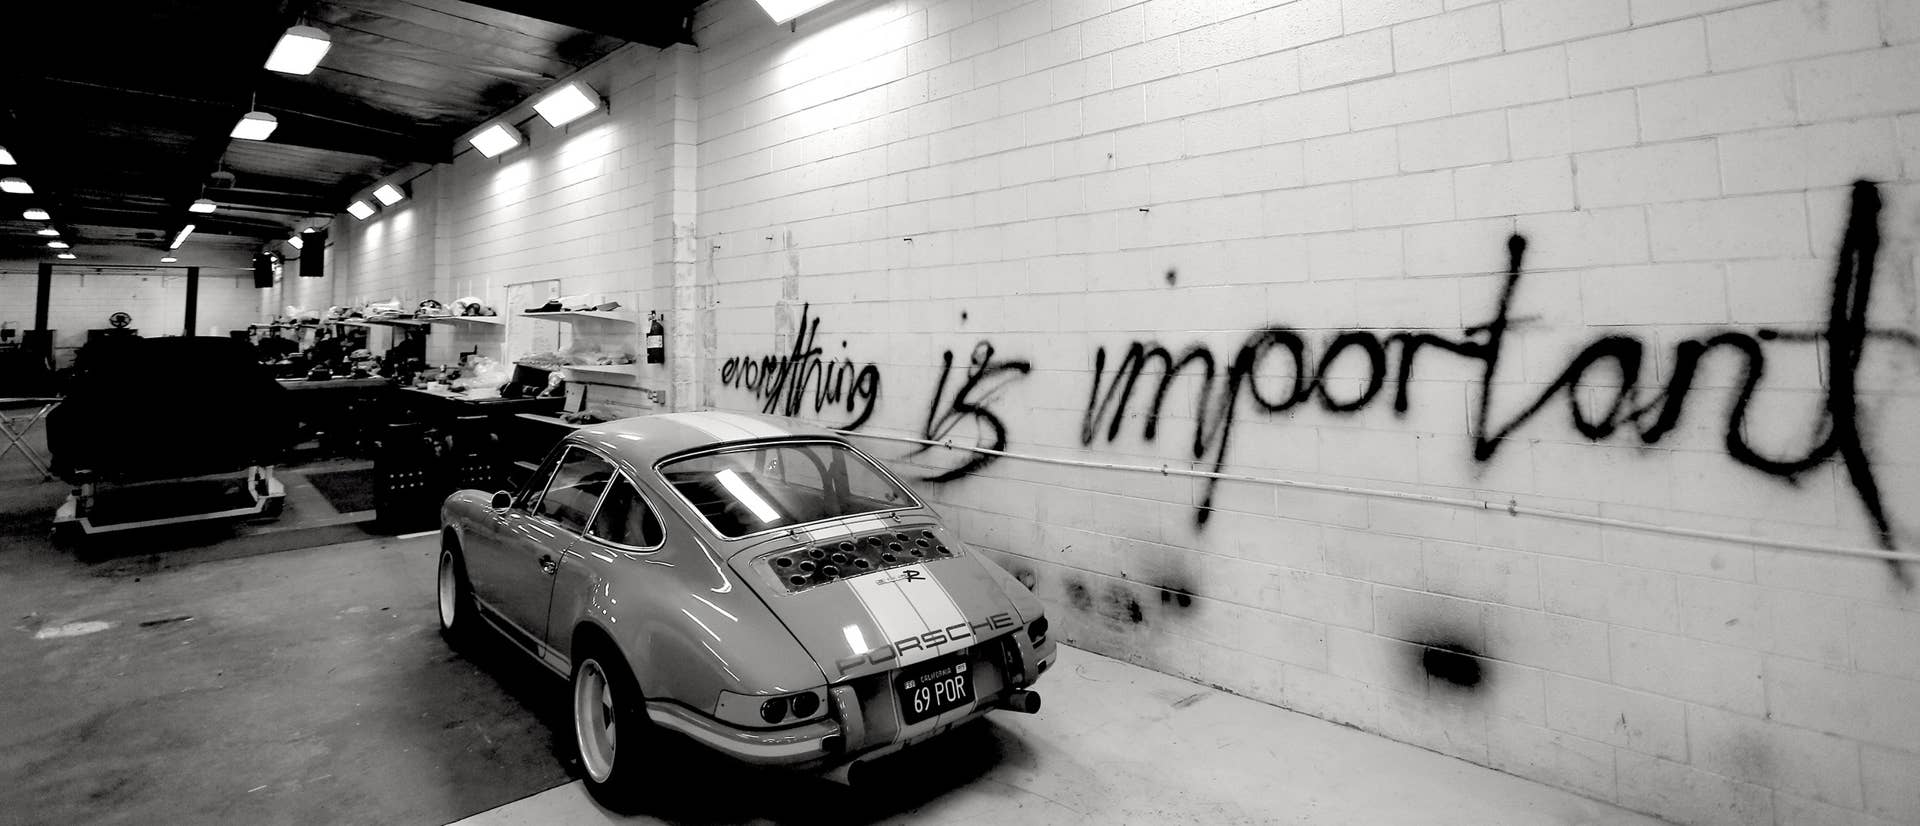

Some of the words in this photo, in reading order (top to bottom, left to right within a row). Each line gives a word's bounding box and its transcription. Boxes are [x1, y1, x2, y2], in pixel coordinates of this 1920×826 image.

[721, 303, 880, 430] everything
[904, 311, 1030, 482] is
[1081, 179, 1920, 590] important
[836, 613, 1014, 673] PORSCHE
[914, 687, 931, 713] 69
[935, 675, 966, 706] POR
[920, 667, 952, 683] CALIFORNIA
